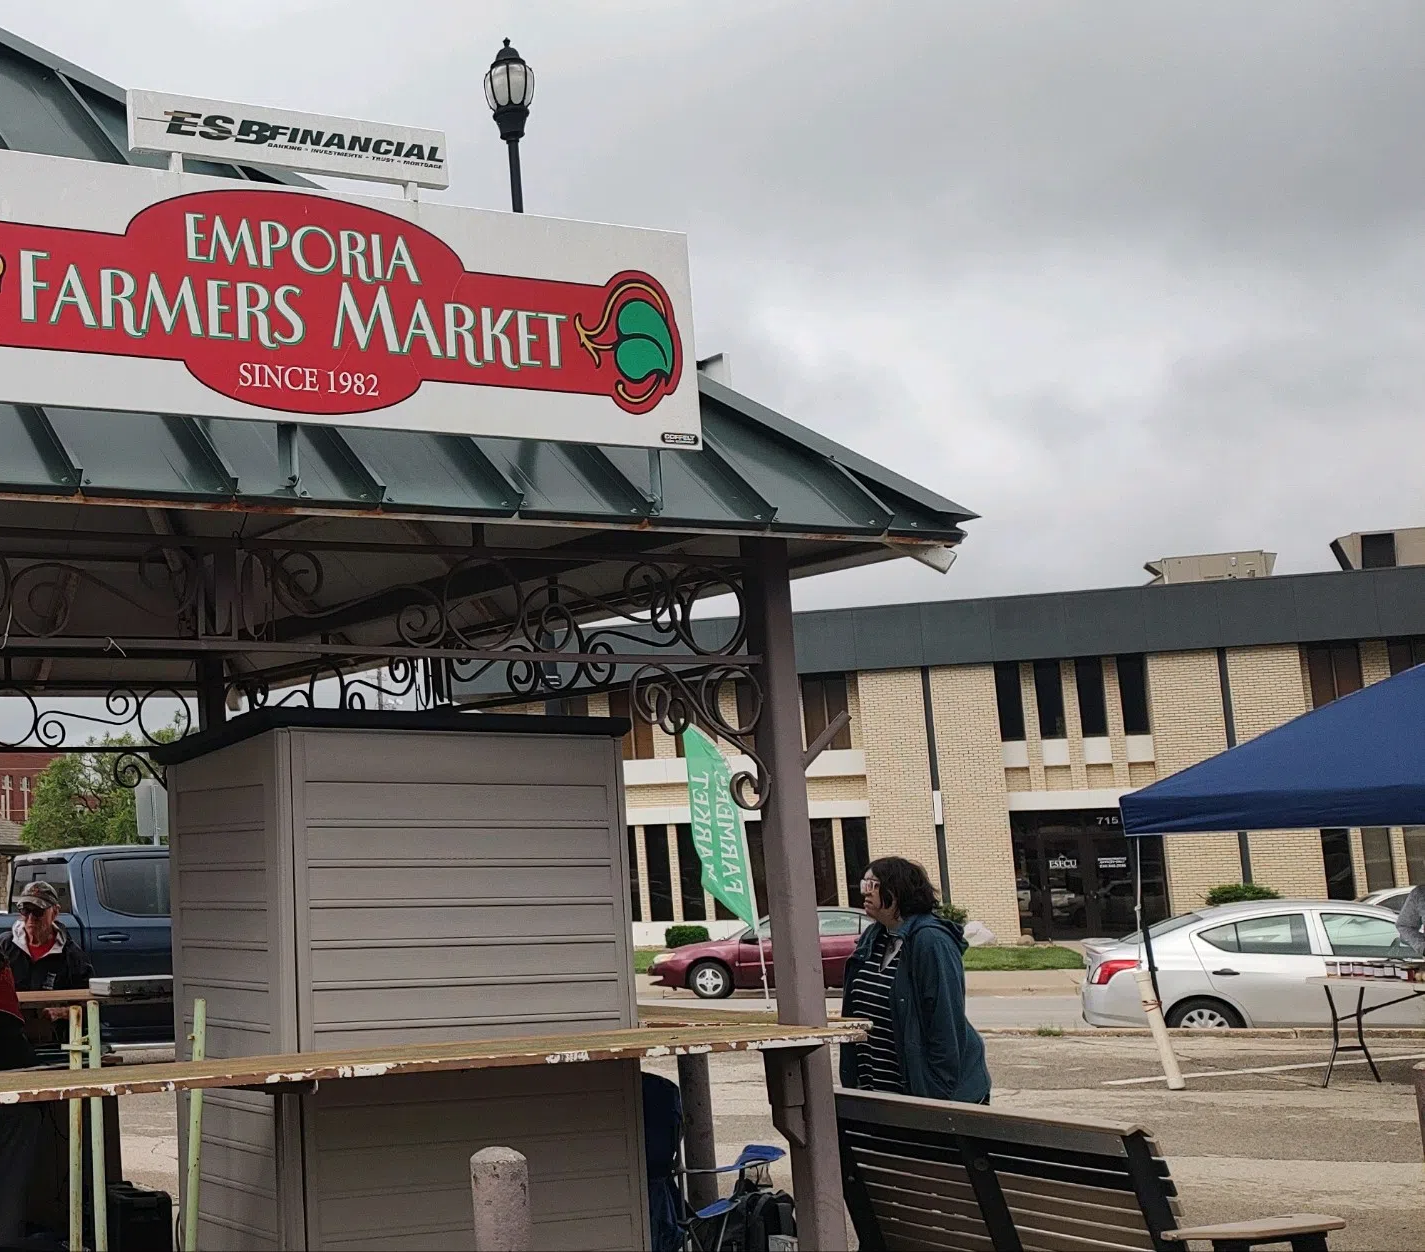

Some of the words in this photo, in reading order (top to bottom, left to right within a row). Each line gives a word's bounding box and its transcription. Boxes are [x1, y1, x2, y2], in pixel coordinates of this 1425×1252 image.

[164, 109, 273, 145] ESB
[268, 125, 445, 162] FINANCIAL
[267, 142, 302, 152] BANKING
[310, 148, 363, 159] INVESTMENTS
[371, 155, 396, 164] TRUST
[402, 159, 443, 169] MORTGAGE
[185, 213, 419, 285] EMPORIA
[19, 248, 305, 349] FARMERS
[332, 291, 568, 370] MARKET
[238, 362, 320, 393] SINCE
[325, 369, 380, 399] 1982
[1096, 816, 1119, 825] 715
